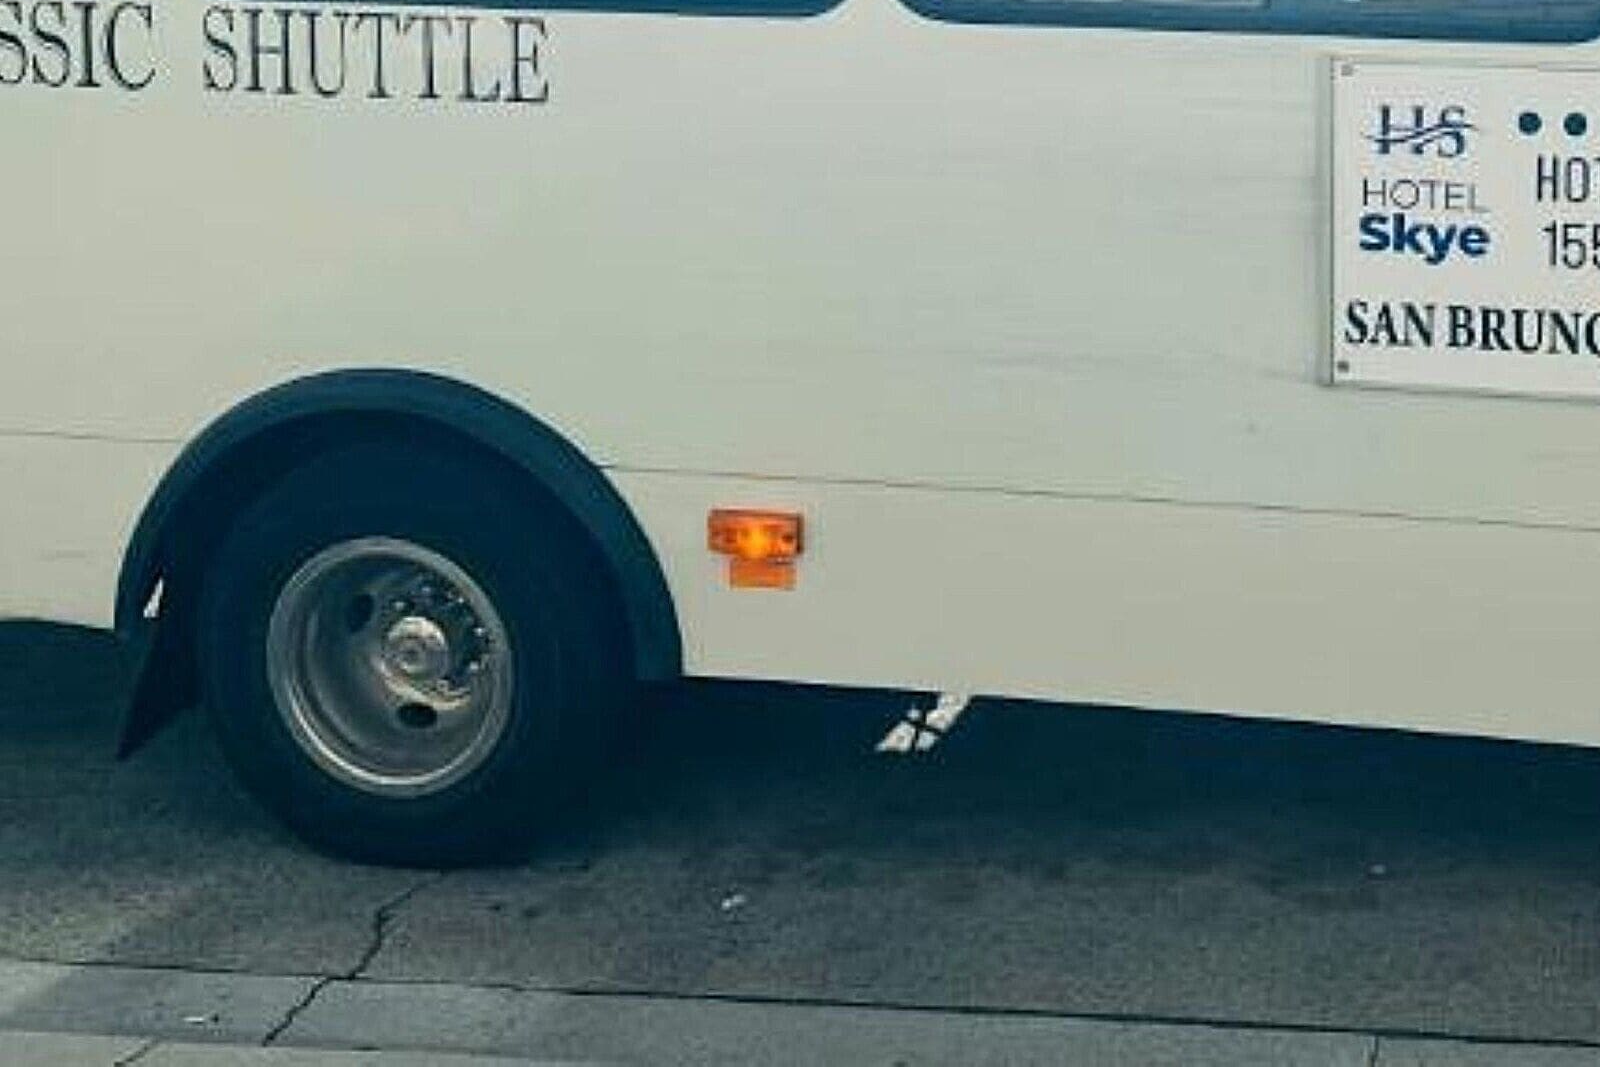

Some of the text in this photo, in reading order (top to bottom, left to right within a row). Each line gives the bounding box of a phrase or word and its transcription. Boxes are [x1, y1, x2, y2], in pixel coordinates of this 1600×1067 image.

[203, 7, 550, 103] SHUTTLE
[1362, 178, 1490, 212] HOTEL
[1359, 213, 1491, 265] Skye
[1344, 300, 1438, 346] SAN
